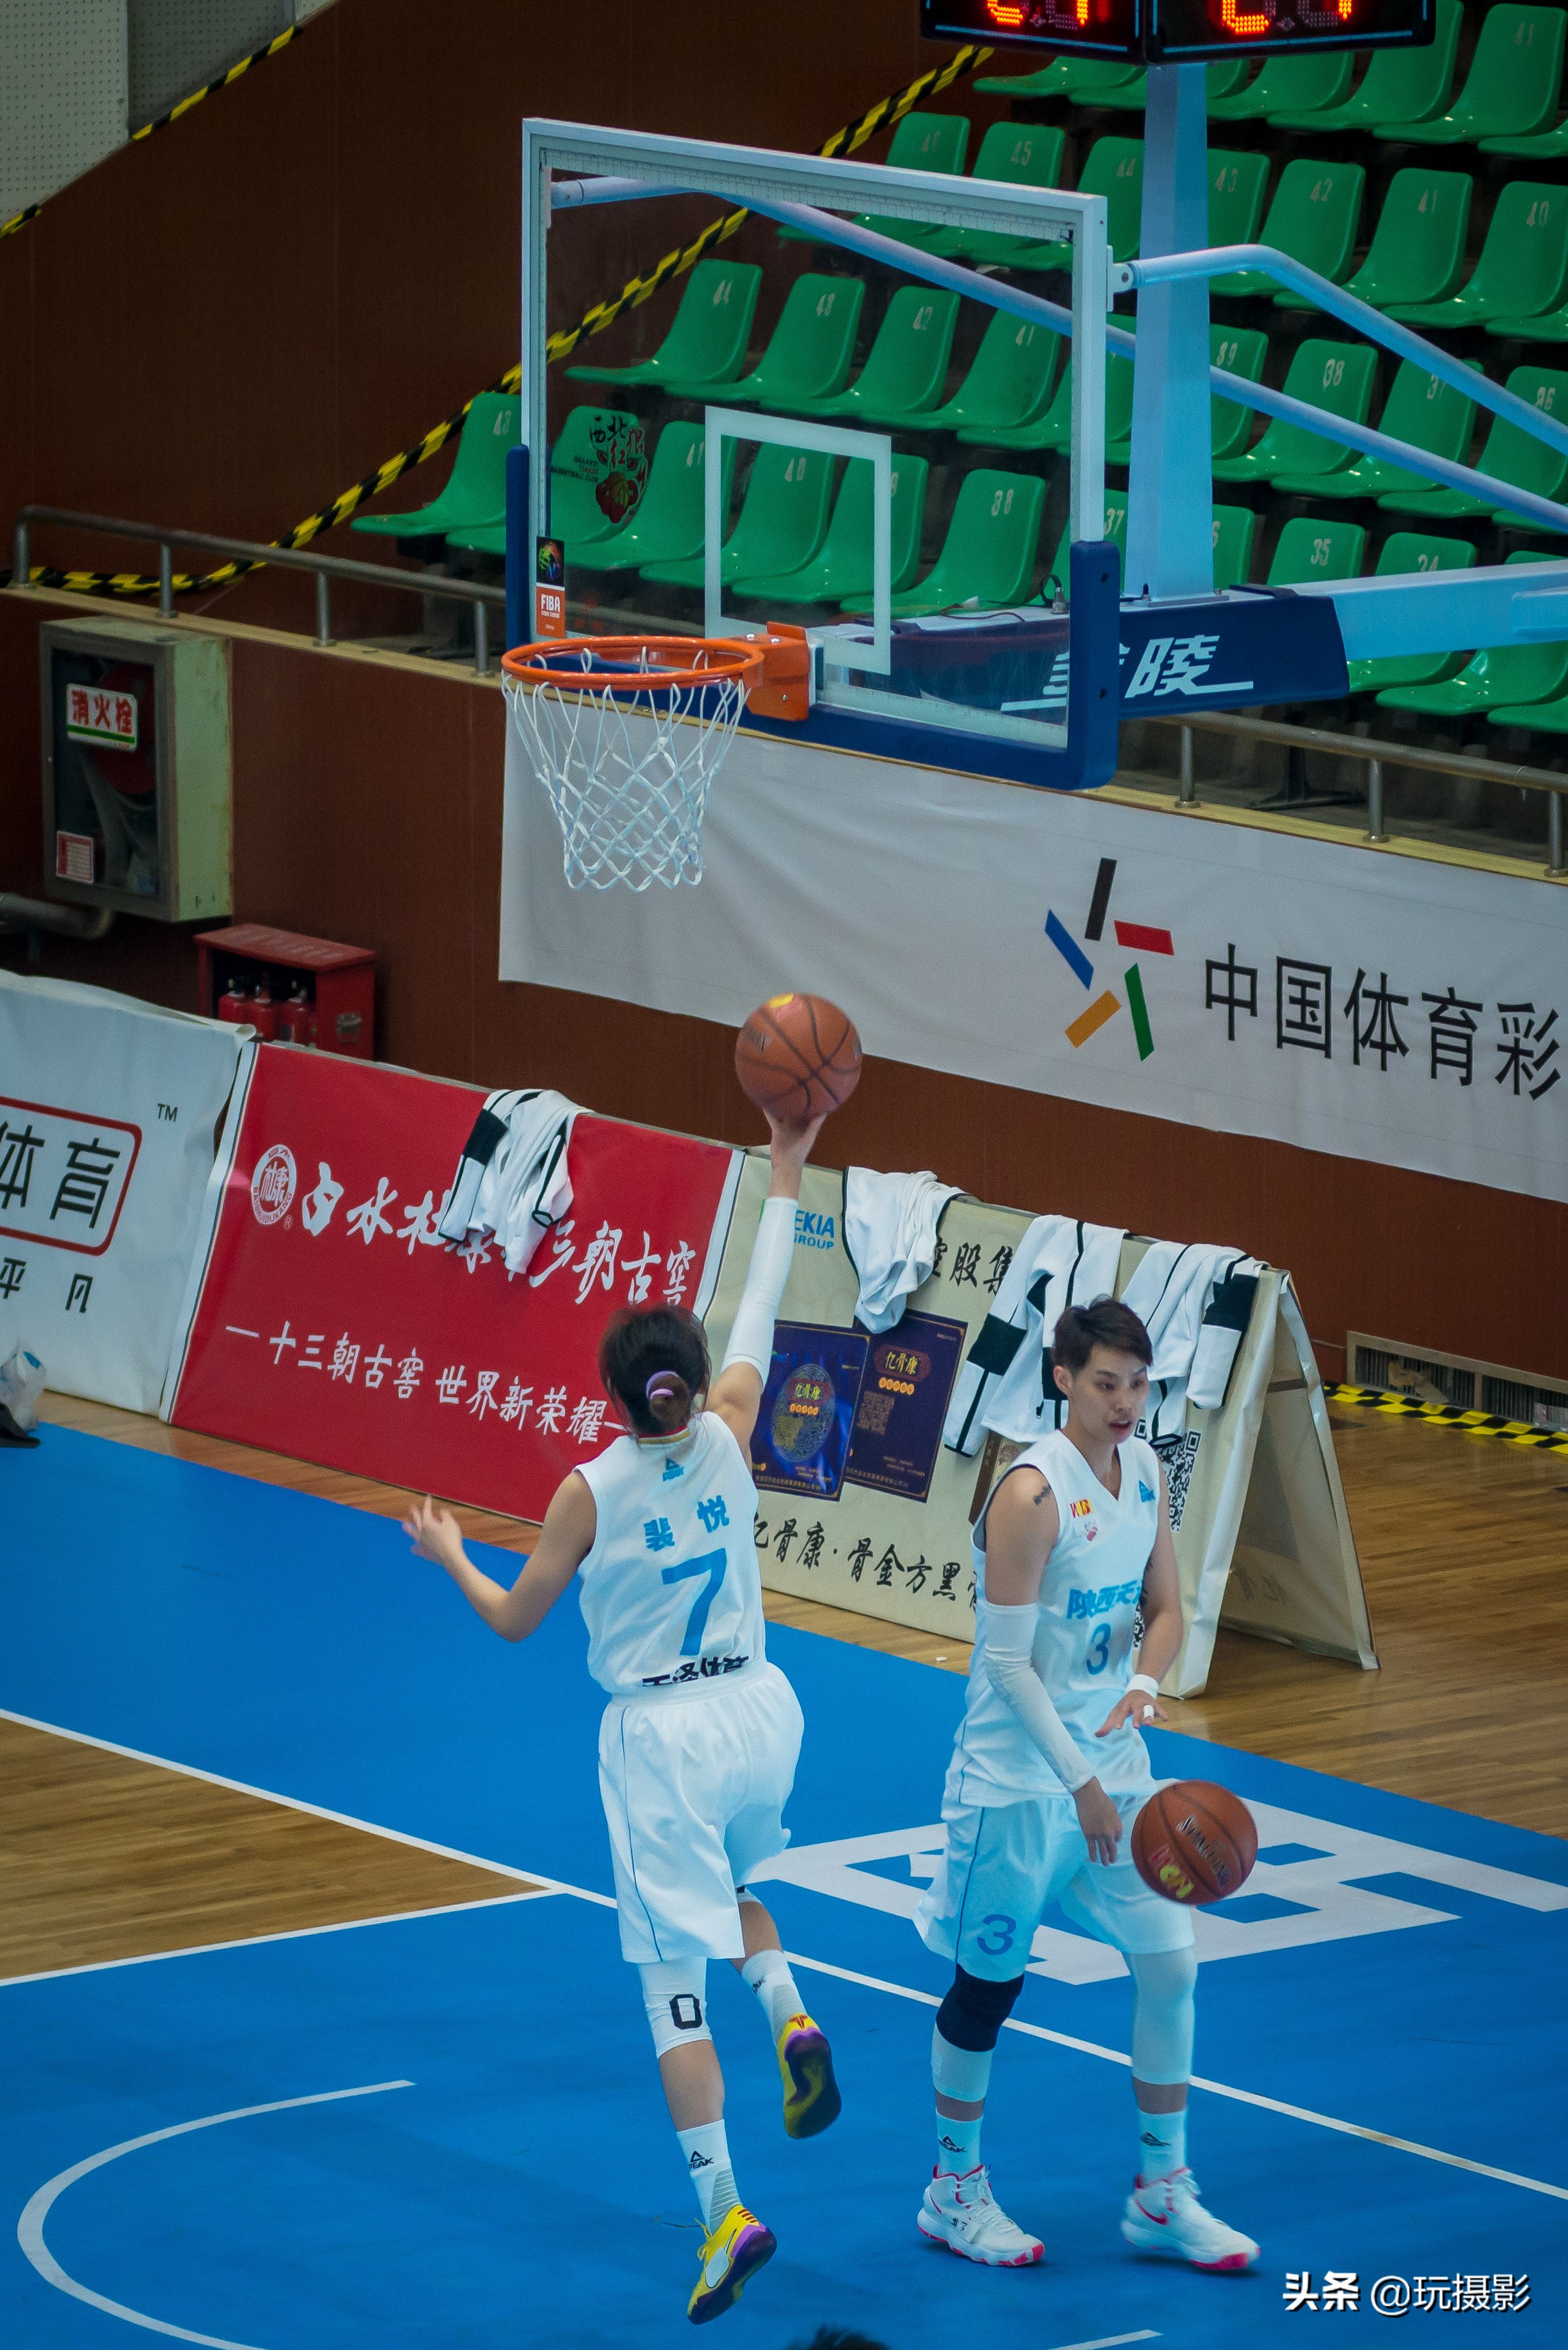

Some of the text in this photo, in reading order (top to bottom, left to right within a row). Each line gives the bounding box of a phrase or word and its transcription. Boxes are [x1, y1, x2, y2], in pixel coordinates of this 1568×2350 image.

[1010, 141, 1032, 166] 45
[1215, 167, 1238, 193] 43
[1310, 178, 1332, 202] 42
[1418, 190, 1438, 216] 41
[1526, 200, 1549, 227] 40
[1310, 538, 1332, 565] 35
[541, 594, 561, 613] FIBA
[71, 688, 133, 735] 消火栓
[1205, 943, 1561, 1100] 中国体育彩
[157, 1103, 177, 1122] TM
[0, 1120, 121, 1229] 体育
[794, 1233, 834, 1250] ROUP
[661, 1547, 728, 1657] 7
[1086, 1622, 1112, 1675] 3
[976, 1914, 1017, 1956] 3
[689, 2157, 714, 2169] PEAK
